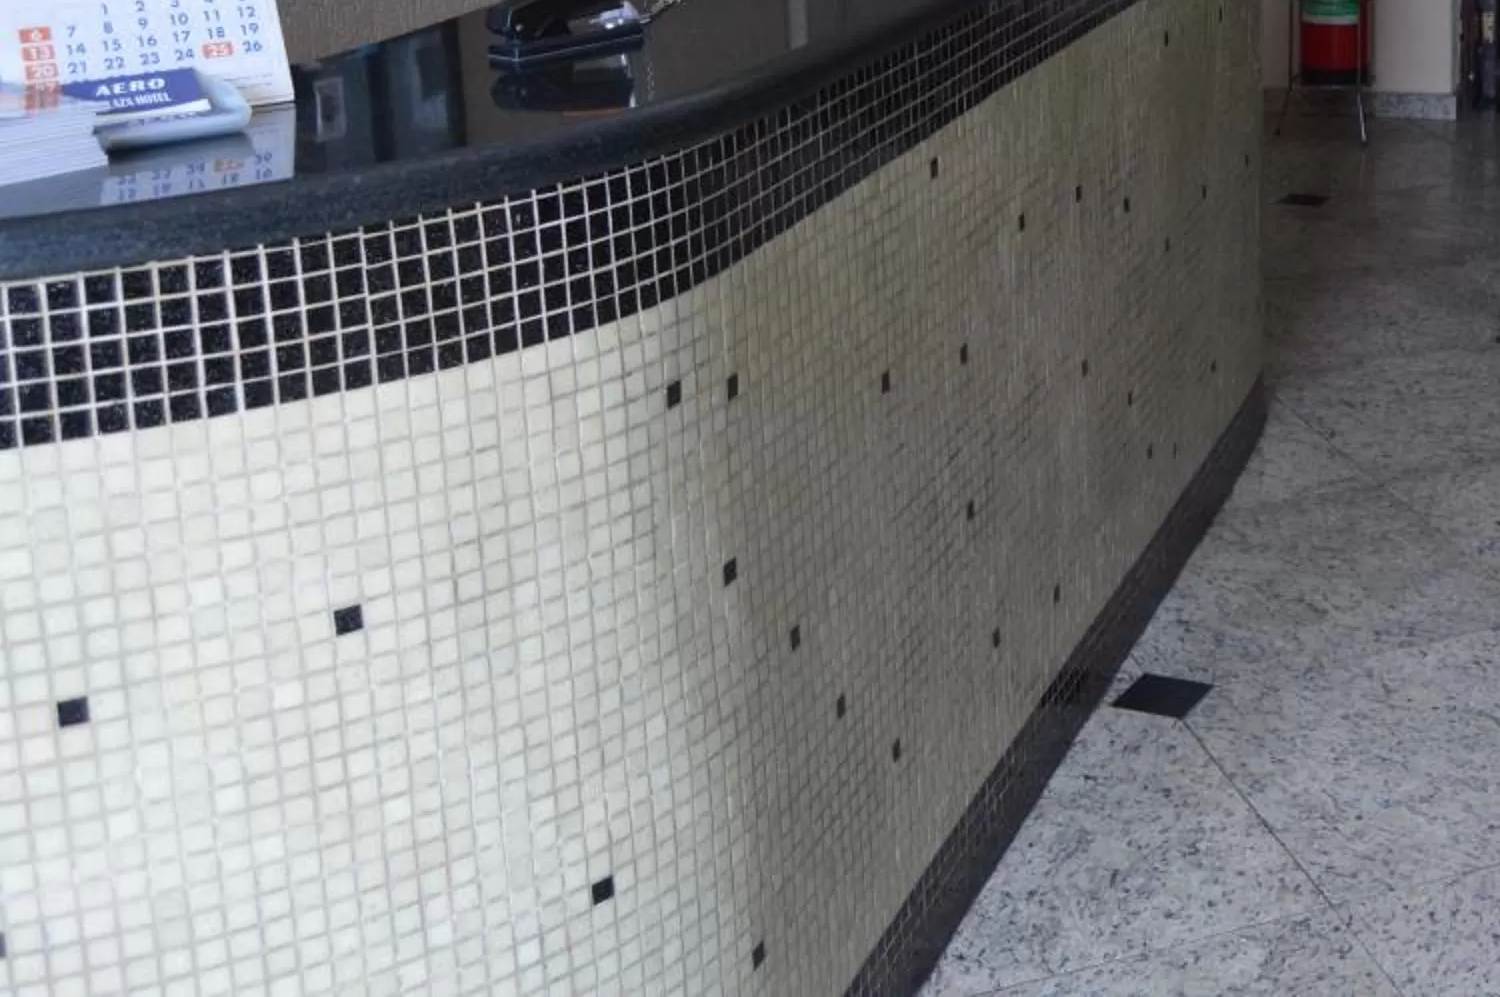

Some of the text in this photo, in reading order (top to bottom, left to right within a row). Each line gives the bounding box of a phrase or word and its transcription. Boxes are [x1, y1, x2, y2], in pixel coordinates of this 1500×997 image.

[66, 25, 76, 37] 7
[137, 17, 148, 30] 9
[170, 13, 189, 26] 10
[203, 9, 221, 22] 11
[237, 6, 256, 18] 12
[101, 3, 108, 15] 1
[136, 0, 145, 12] 2
[67, 42, 86, 55] 14
[103, 39, 122, 52] 15
[137, 35, 157, 48] 16
[173, 31, 191, 43] 17
[207, 27, 225, 39] 18
[240, 22, 259, 35] 19
[67, 61, 87, 74] 21
[104, 56, 125, 70] 22
[139, 52, 160, 65] 23
[175, 48, 195, 61] 24
[242, 40, 262, 53] 26
[96, 78, 166, 97] AERO
